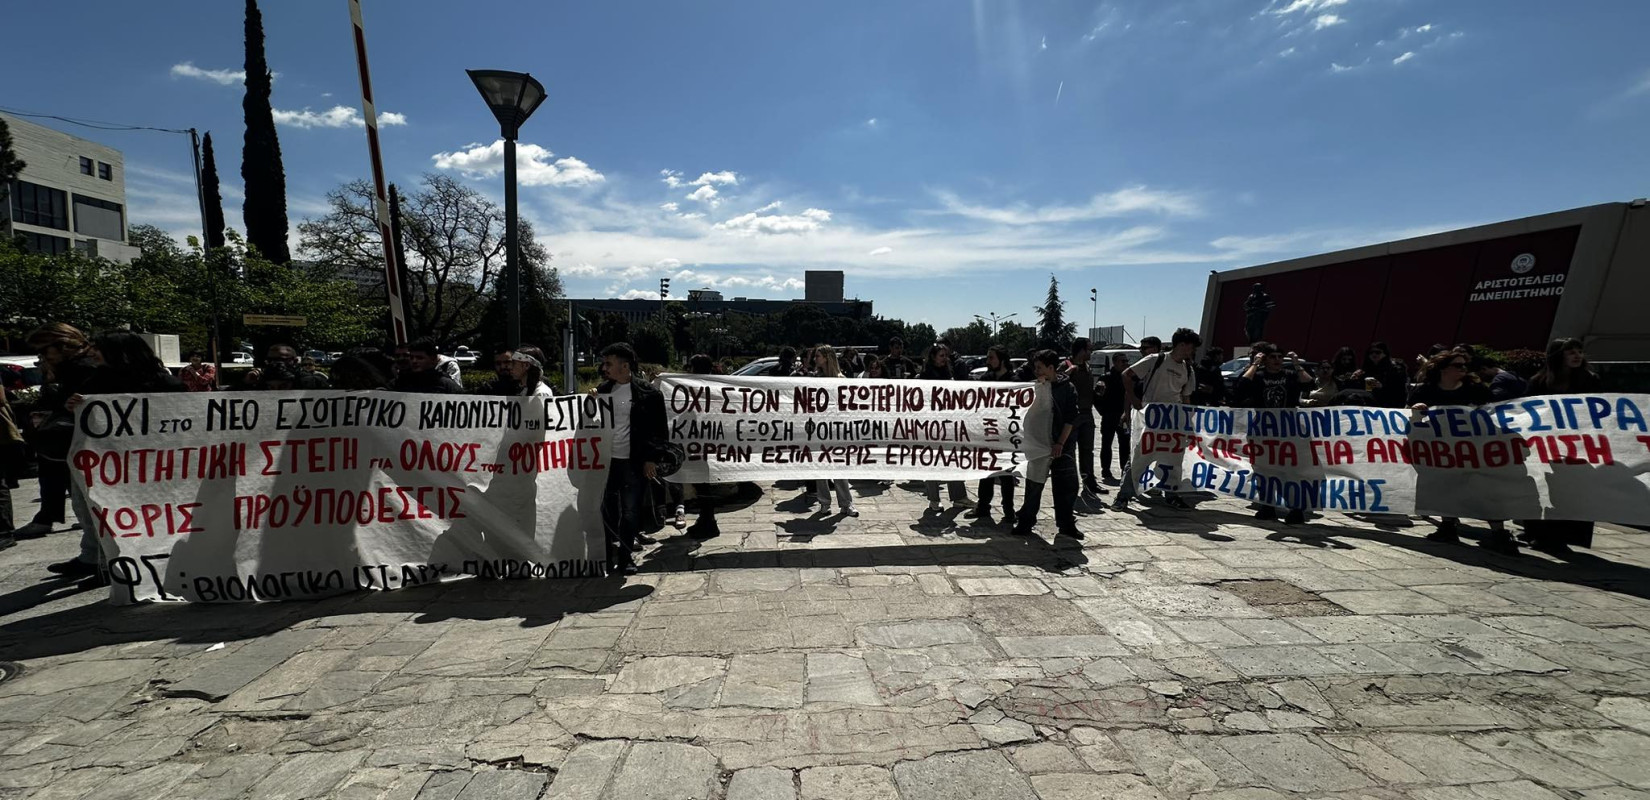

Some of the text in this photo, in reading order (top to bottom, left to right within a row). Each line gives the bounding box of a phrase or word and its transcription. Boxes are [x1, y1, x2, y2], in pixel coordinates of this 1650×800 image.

[1469, 286, 1564, 302] ΠΑΝΕΠΙΣΤΗΜΙΟ
[1475, 273, 1565, 290] ΑΡΙΣΤΟΤΕΛΕΙΟ
[671, 384, 1035, 413] ΟΧΙ ΣΤΟΝ ΝΕΟ ΕΣΩΤΕΡΙΚΟ ΚΑΝΟΝΙΣΜΟ
[80, 398, 149, 438] ΟΧΙ
[159, 418, 192, 433] ΣΤΟ
[206, 399, 259, 431] ΝΕΟ
[276, 396, 406, 430] ΕΣΩΤΕΡΙΚΟ
[419, 400, 521, 430] ΚΑΝΟΝΙΣΜΟ
[544, 395, 615, 431] ΕΣΤΙΩΝ
[672, 419, 724, 440] ΚΑΜΙΑ
[736, 420, 793, 441] ΕΞΩΣΗ
[892, 417, 970, 442] ΔΗΜΟΣΙΑ
[1145, 404, 1178, 430] ΟΧΙ
[1183, 405, 1234, 435] ΣΤΟΝ
[73, 442, 246, 487] ΦΟΙΤΗΤΙΚΗ
[259, 438, 358, 475] ΣΤΕΓΗ
[370, 458, 393, 470] ΓΙΑ
[401, 439, 480, 472] ΟΛΟΥΣ
[509, 437, 605, 475] ΦΟΙΤΗΤΕΣ
[762, 445, 812, 463] ΕΣΤΙΑ
[819, 444, 878, 466] ΧΩΡΙΣ
[886, 444, 1003, 471] ΕΡΓΟΛΑΒΙΕΣ
[1309, 438, 1354, 466] ΓΙΑ
[1367, 434, 1614, 468] ΑΝΑΒΑΘΜΙΣΗ
[1139, 462, 1389, 512] Φ.Σ. ΘΕΣΣΑΛΟΝΙΚΗΣ
[92, 485, 466, 537] ΧΩΡΙΣ ΠΡΟΫΠΟΘΕΣΕΙΣ
